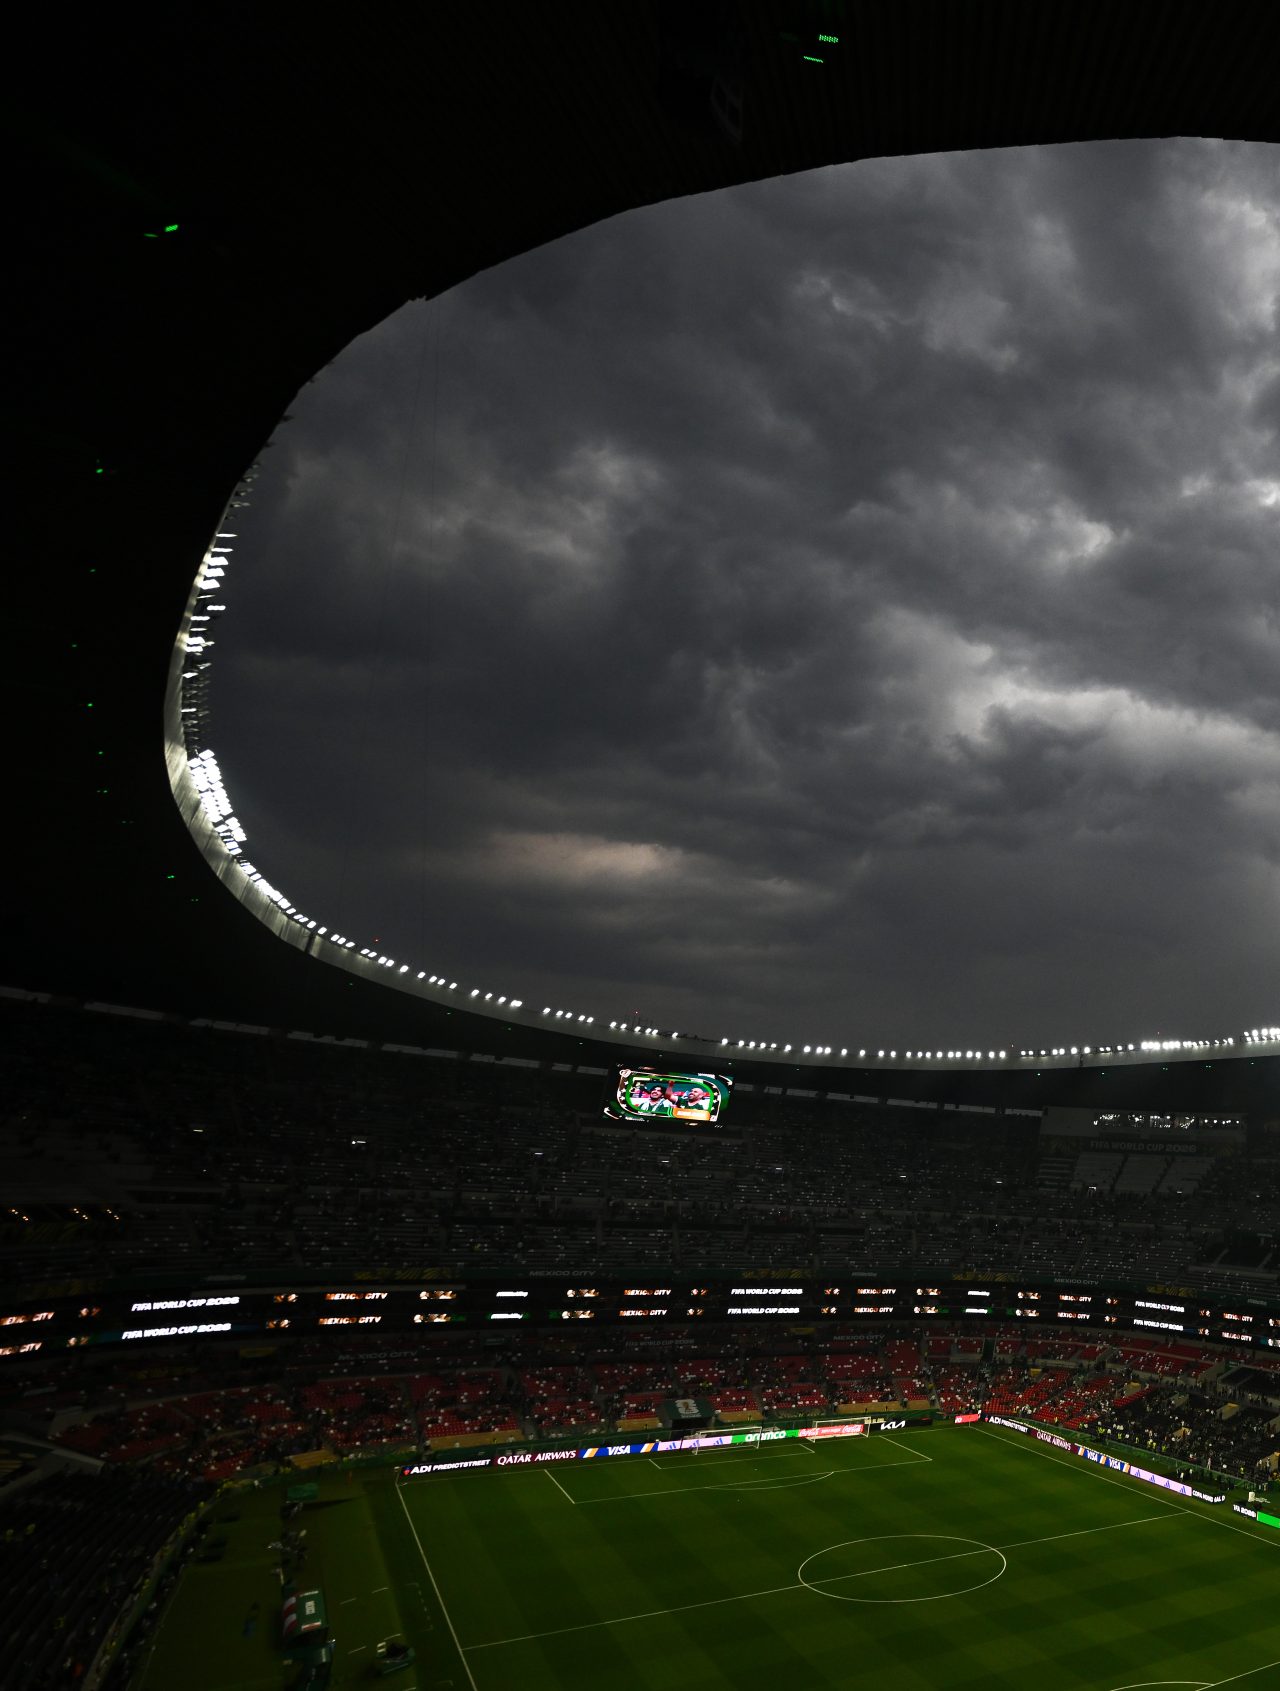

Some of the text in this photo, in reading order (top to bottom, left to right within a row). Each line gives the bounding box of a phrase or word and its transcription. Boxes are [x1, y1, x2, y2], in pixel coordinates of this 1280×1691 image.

[325, 1292, 388, 1301] MEXICO CITY
[132, 1303, 152, 1312] FIFA
[153, 1301, 186, 1310] WORLD
[187, 1299, 206, 1308] CUP
[319, 1316, 381, 1325] MEXICO CITY
[122, 1330, 143, 1340] FIFA
[144, 1327, 177, 1338] WORLD
[177, 1325, 198, 1335] CUP
[880, 1420, 905, 1430] KIA
[989, 1416, 1002, 1424] ADI
[745, 1430, 786, 1442] aramco
[1036, 1431, 1072, 1451] QATAR AIRWAYS
[607, 1445, 631, 1455] VISA
[1086, 1449, 1099, 1462] VISA
[497, 1450, 577, 1465] QATAR AIRWAYS
[410, 1459, 490, 1475] ADI PREDICTSTREET
[1108, 1458, 1121, 1471] VISA
